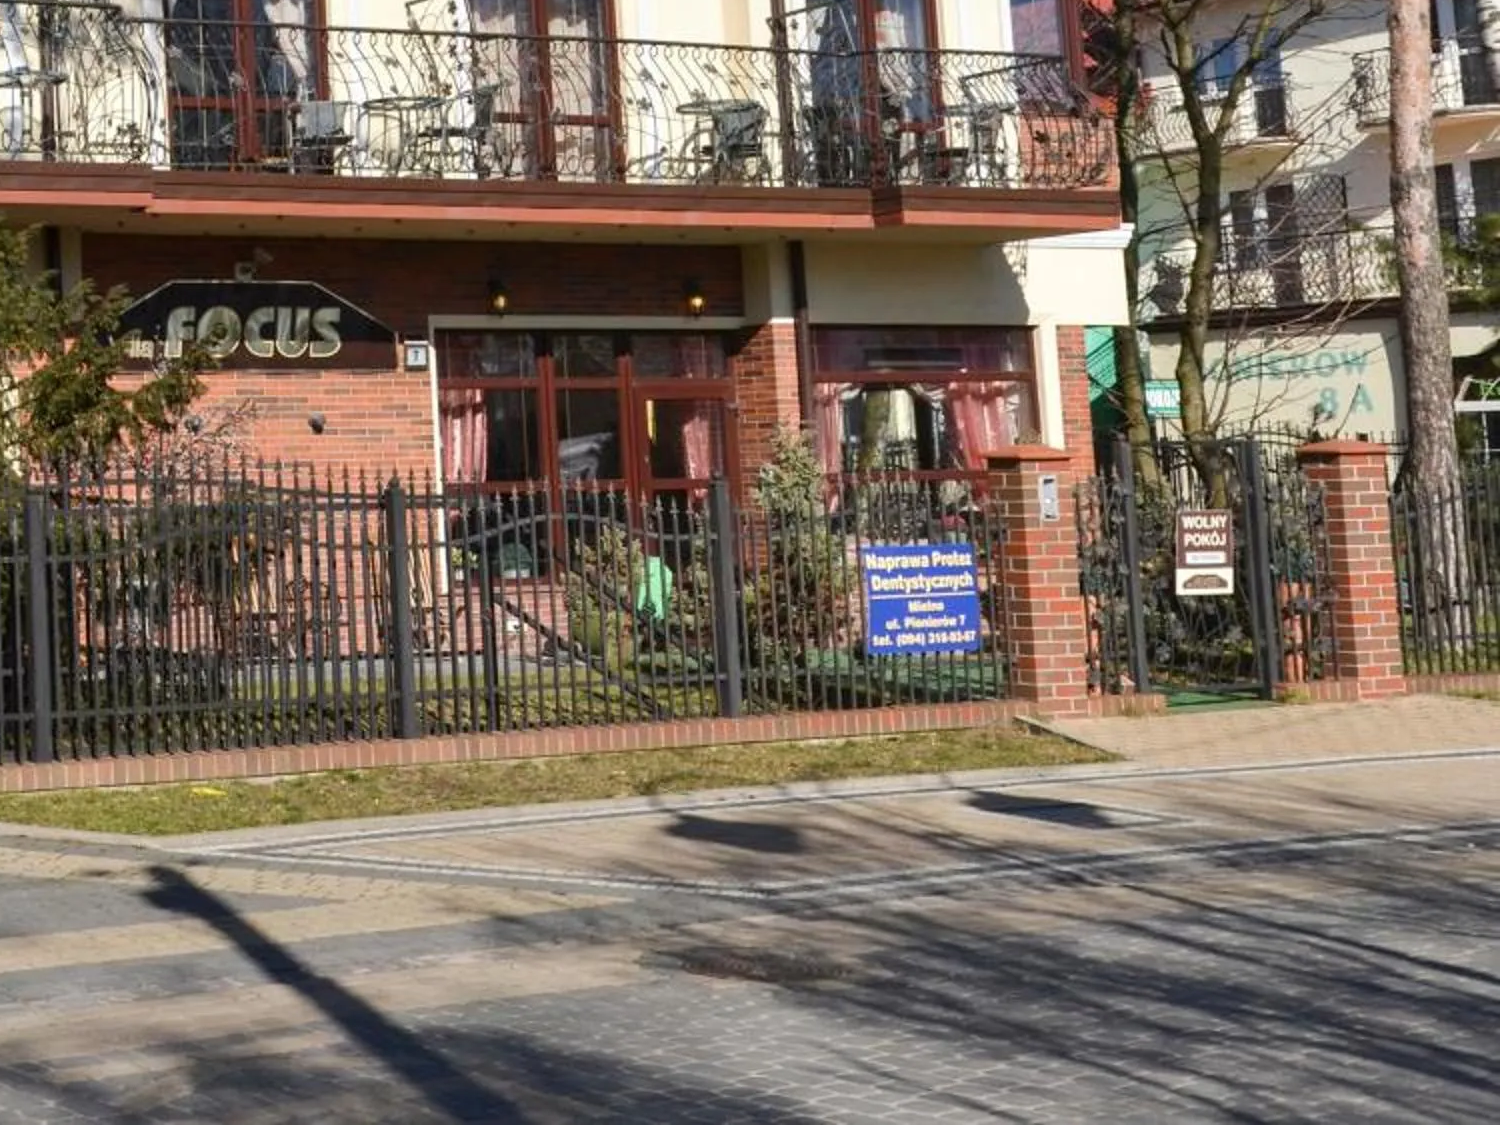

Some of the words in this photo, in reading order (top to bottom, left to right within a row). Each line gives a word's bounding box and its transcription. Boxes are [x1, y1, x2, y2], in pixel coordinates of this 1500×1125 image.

[164, 305, 342, 359] FOCUS
[1181, 515, 1227, 529] WOLNY
[1184, 531, 1227, 547] POKÓJ
[865, 554, 929, 573] Naprawa
[932, 550, 972, 567] Protez
[871, 572, 973, 593] Dentystycznych
